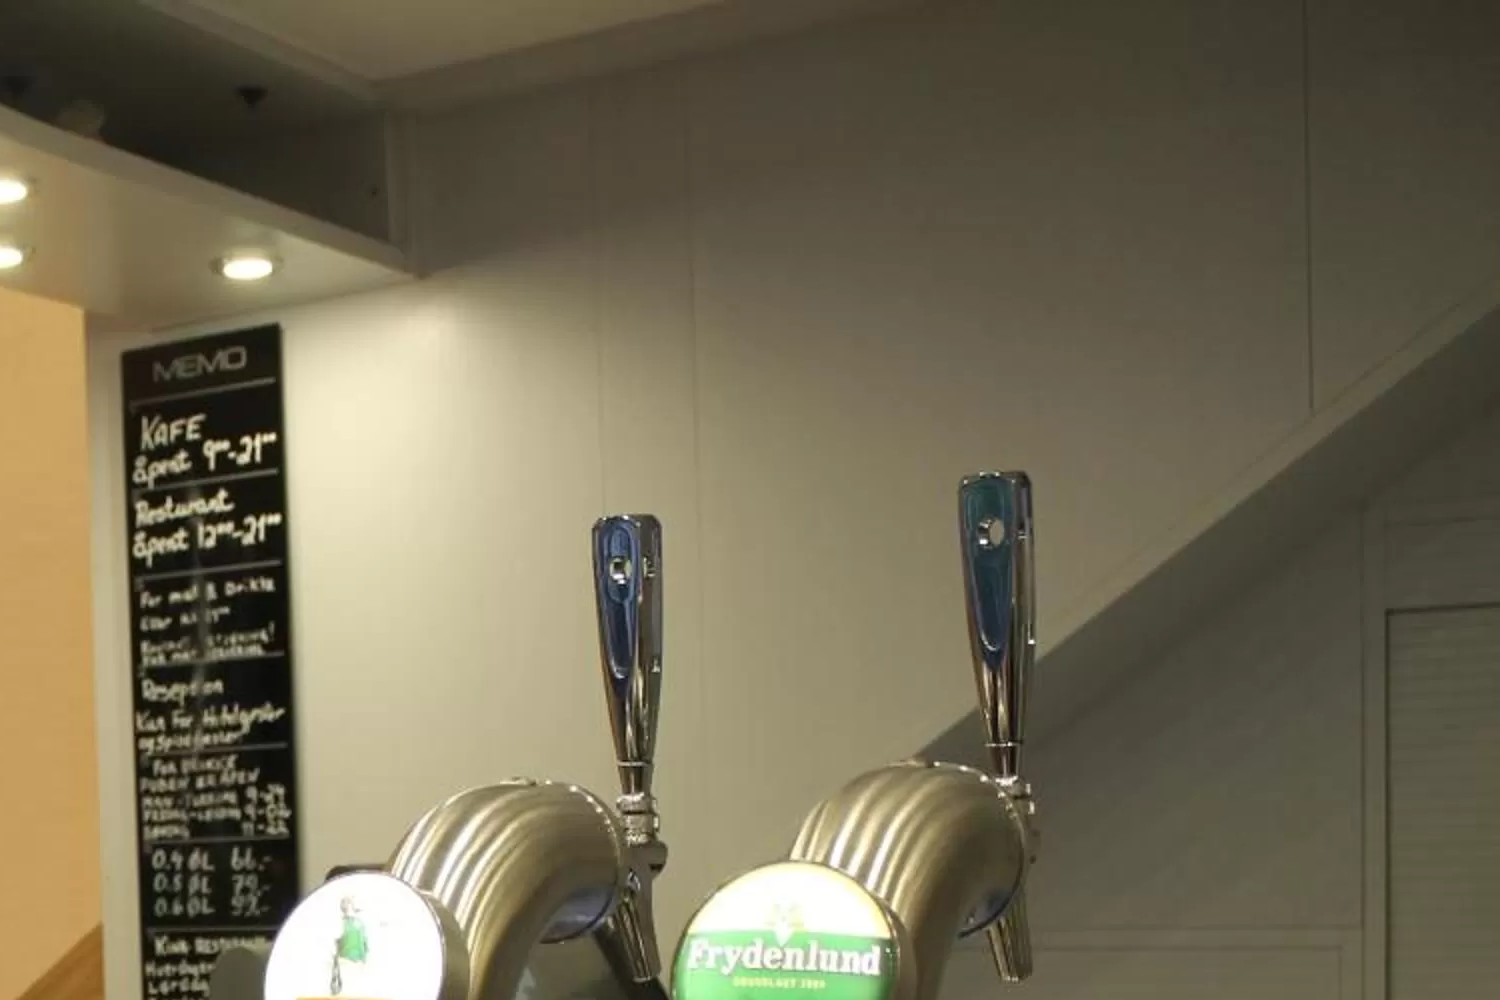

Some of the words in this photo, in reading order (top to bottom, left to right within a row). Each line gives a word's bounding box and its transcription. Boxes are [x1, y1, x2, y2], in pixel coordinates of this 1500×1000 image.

[153, 345, 248, 382] MEMO
[141, 413, 207, 451] KAFE
[687, 936, 881, 976] Frydenlund
